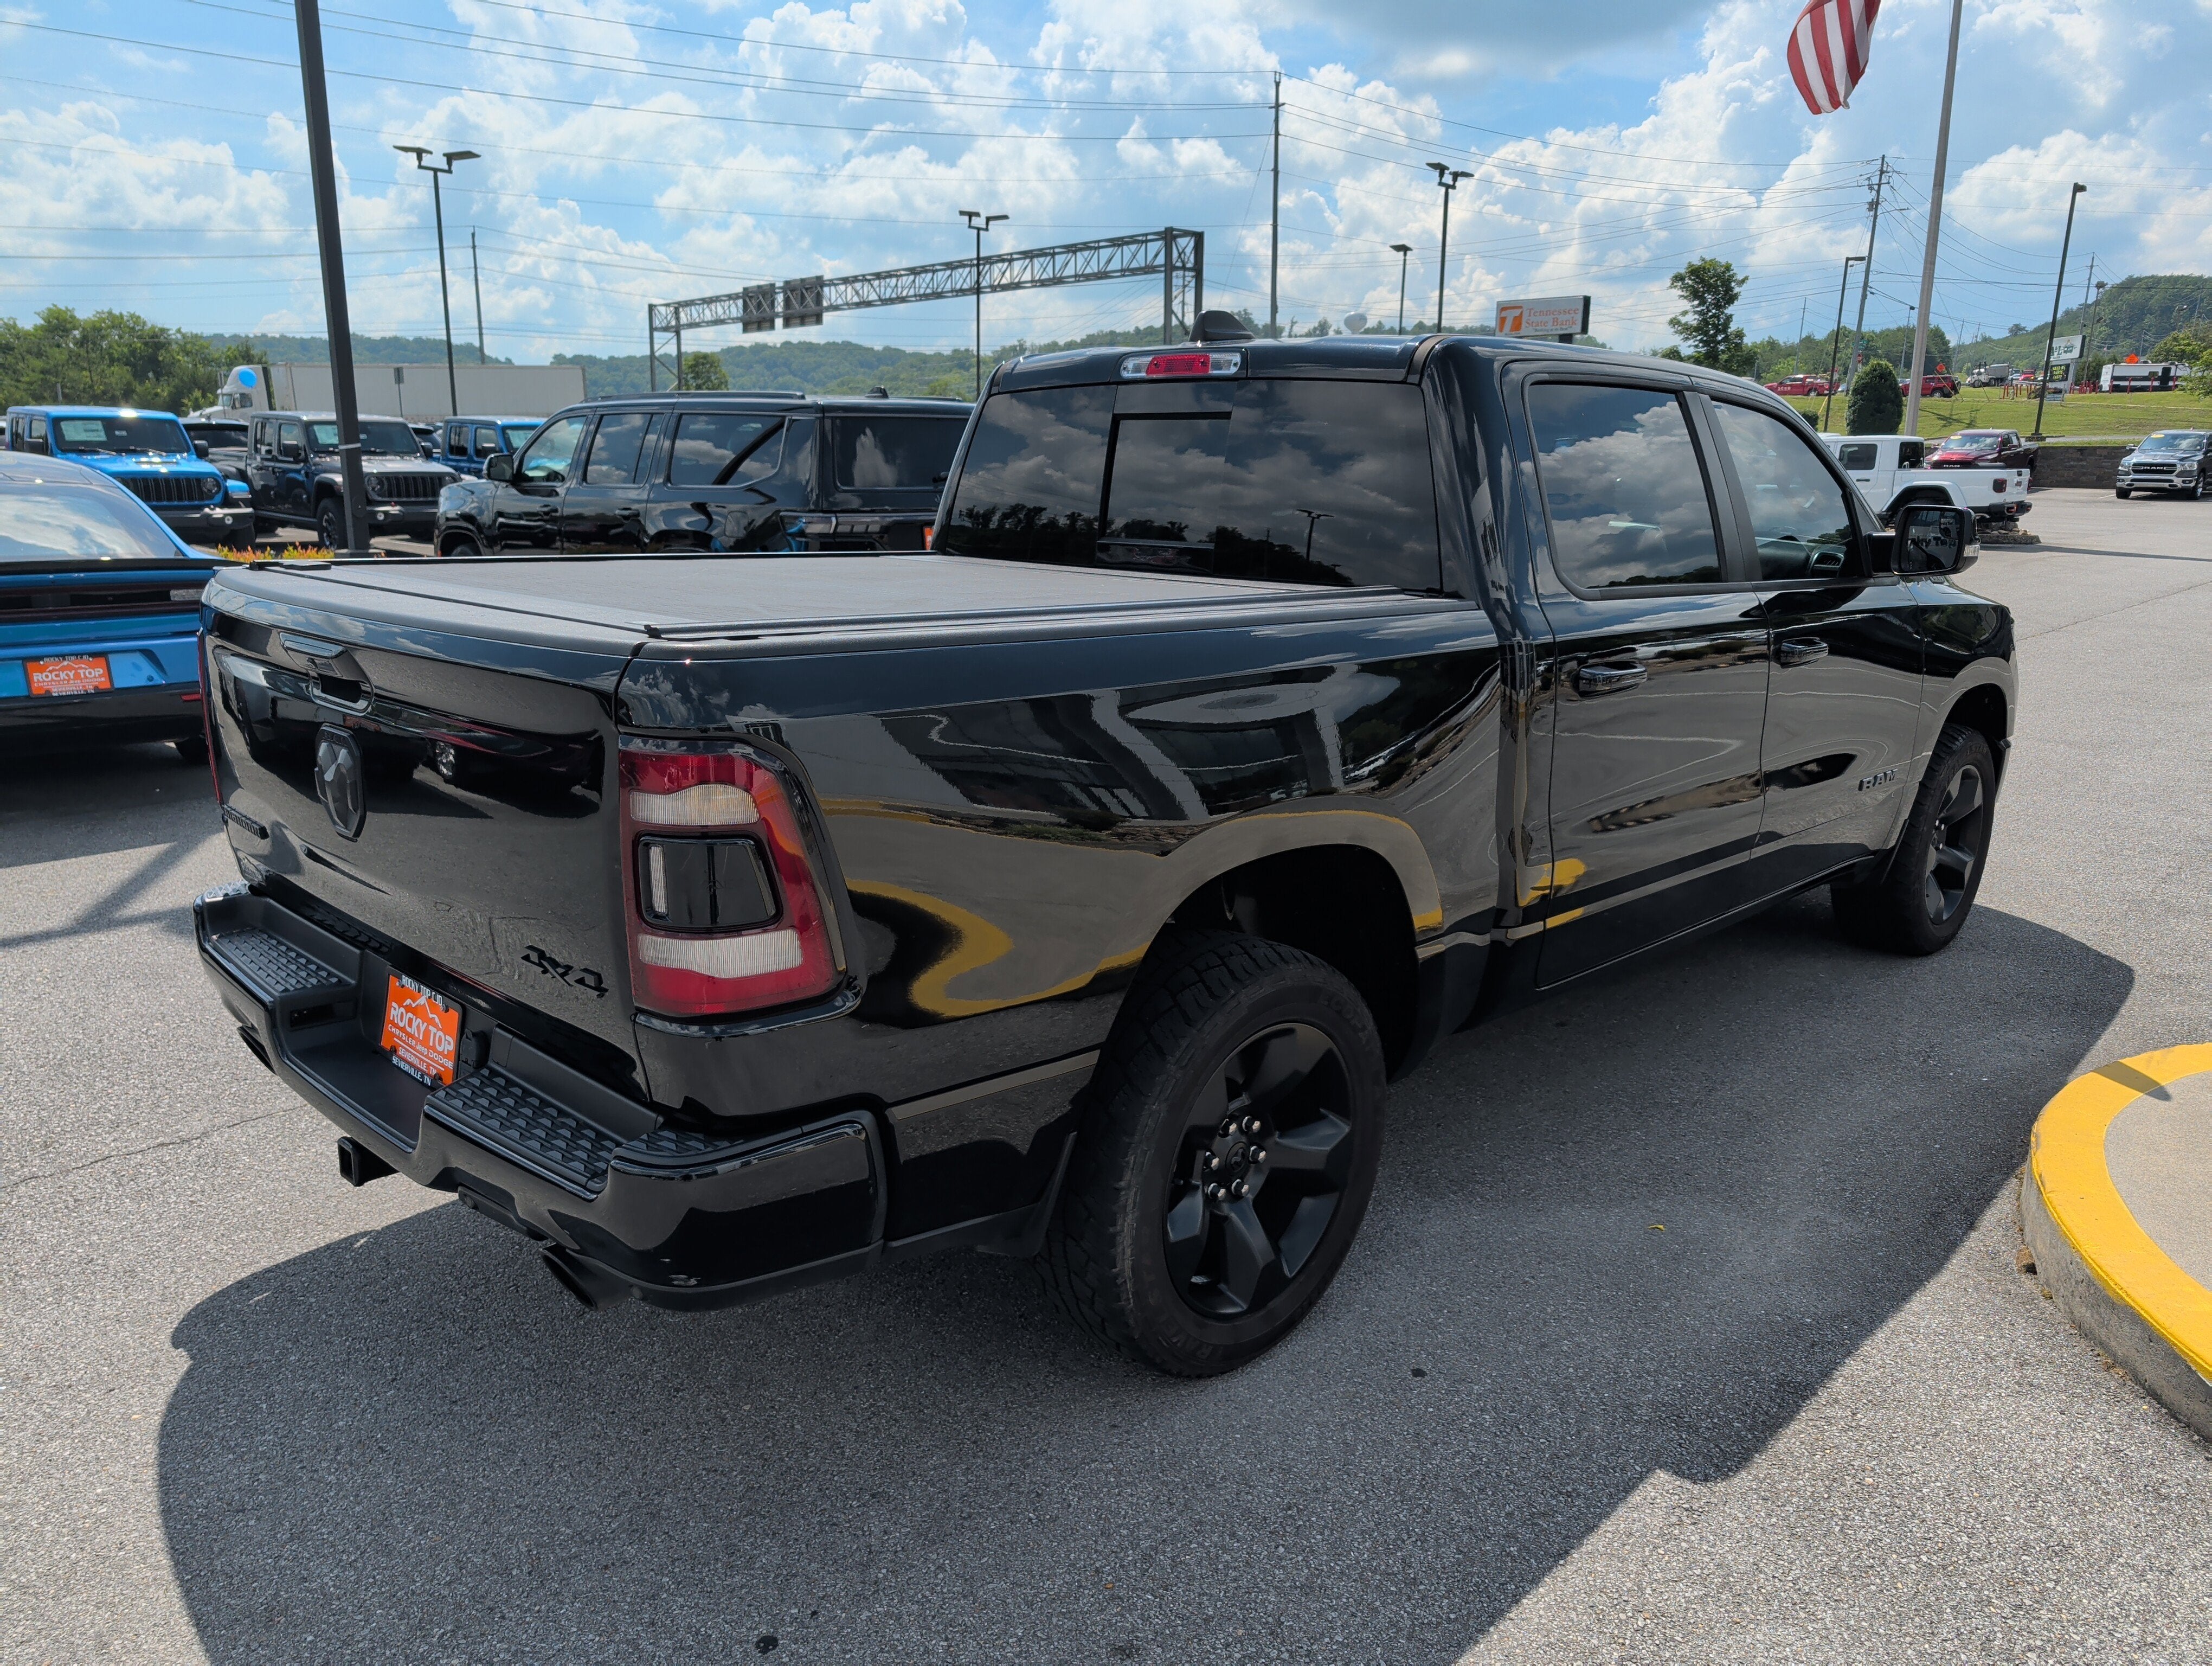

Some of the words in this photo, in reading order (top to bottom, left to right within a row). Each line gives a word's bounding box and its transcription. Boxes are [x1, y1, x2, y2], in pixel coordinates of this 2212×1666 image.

[1525, 318, 1548, 328] State
[1552, 316, 1577, 327] Bank
[1526, 307, 1579, 317] Tennessee
[33, 670, 75, 682] ROCKY
[78, 668, 104, 678] TOP
[1858, 768, 1898, 791] RAM
[402, 975, 420, 993] ROCKY
[420, 985, 431, 999] TOP
[432, 991, 443, 1006] CJD
[390, 1001, 427, 1040] ROCKY
[429, 1024, 454, 1055] TOP
[388, 1023, 416, 1047] CHRYSLER
[416, 1040, 428, 1056] Jeep
[428, 1049, 454, 1070] DODGE
[392, 1055, 423, 1082] SEVIERVILLE,
[423, 1074, 432, 1086] TN
[398, 1047, 428, 1073] SEVIERVILLE,
